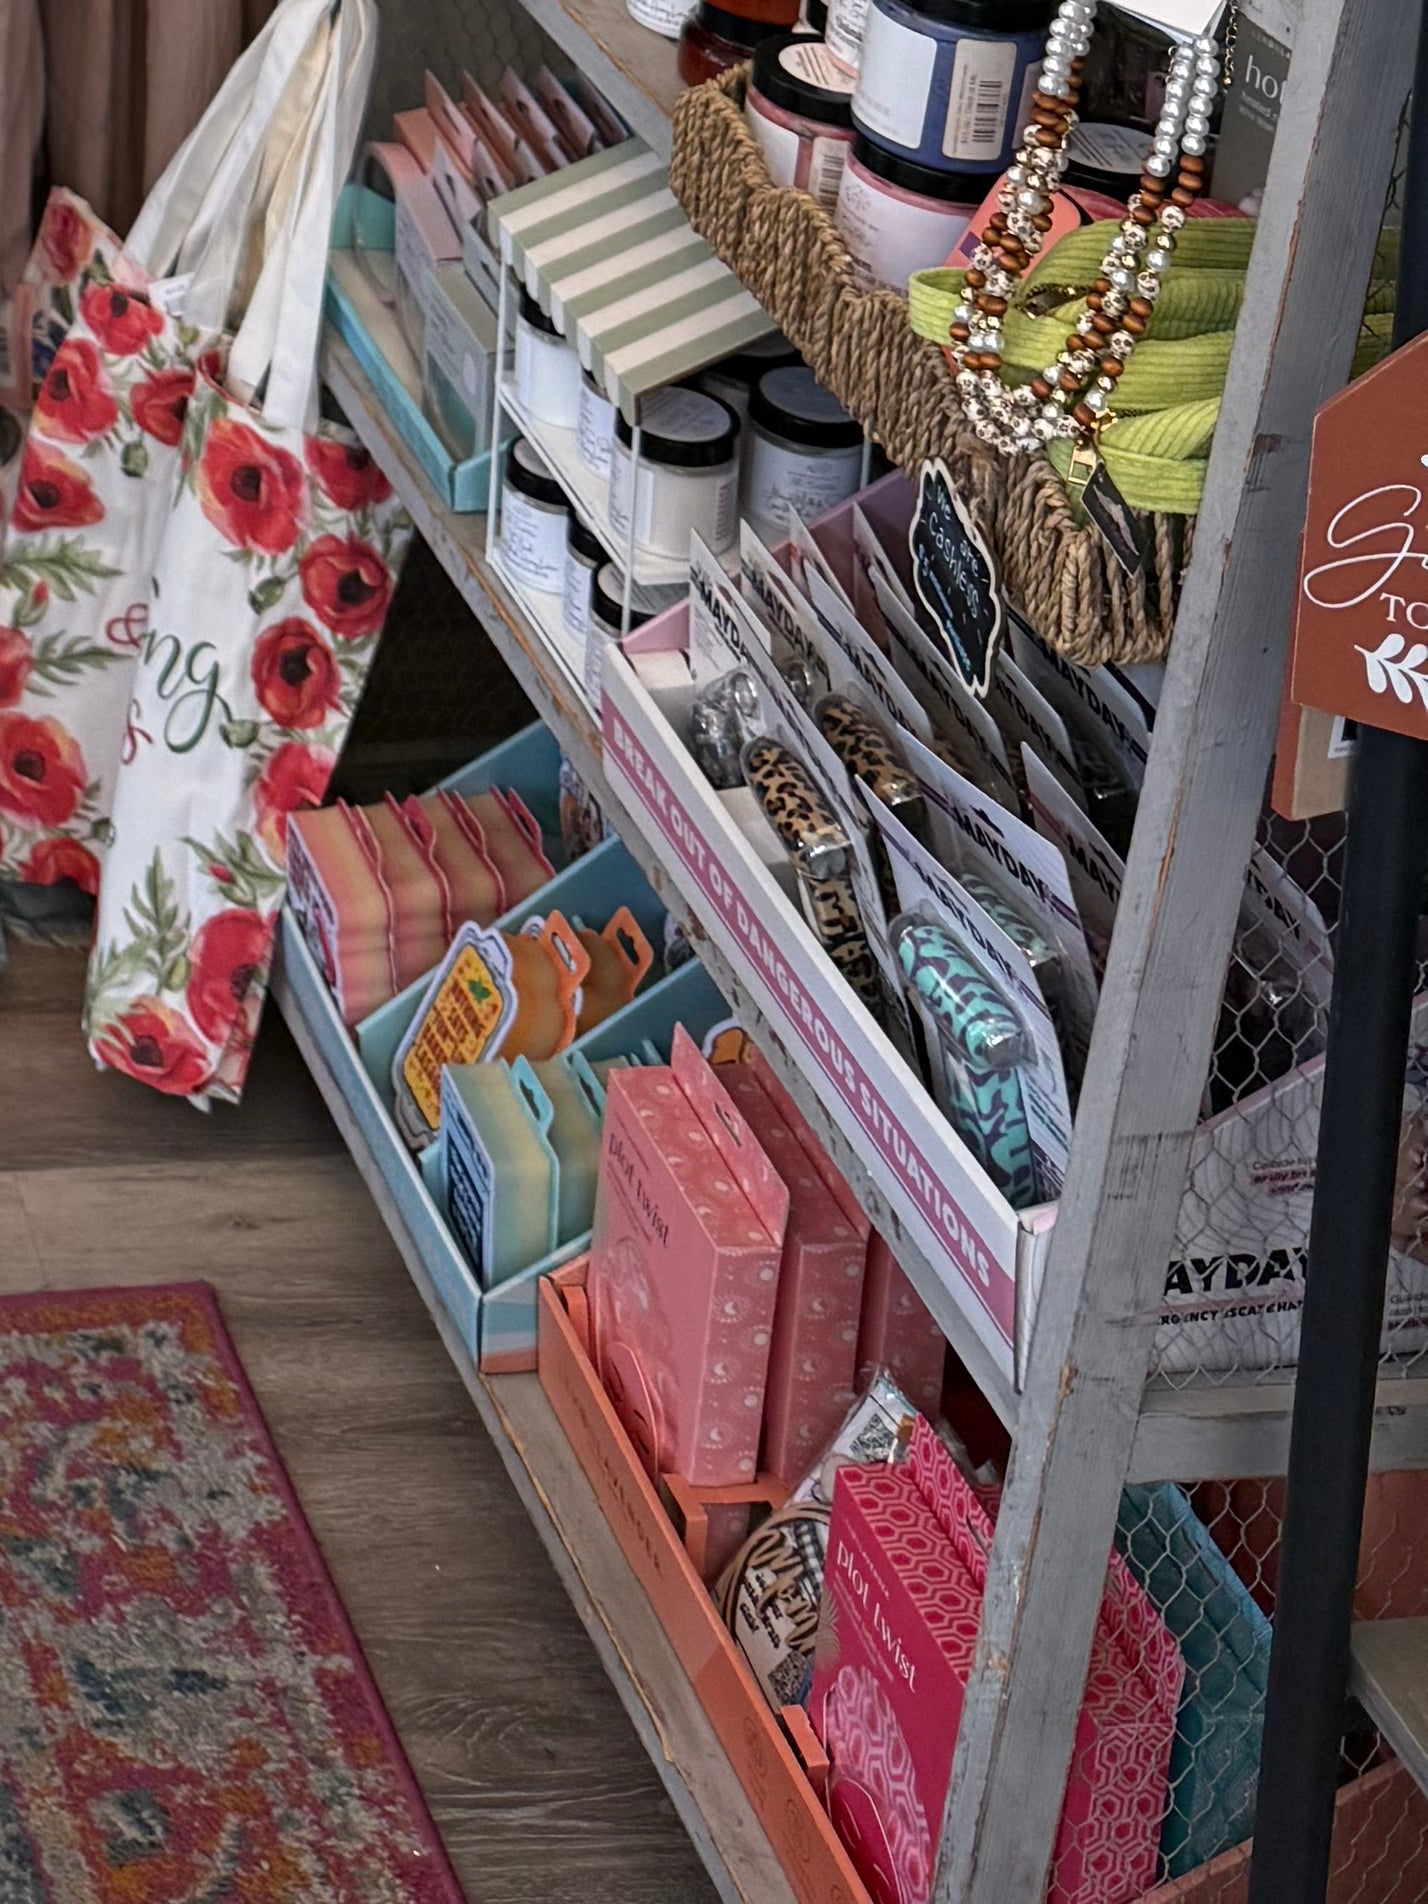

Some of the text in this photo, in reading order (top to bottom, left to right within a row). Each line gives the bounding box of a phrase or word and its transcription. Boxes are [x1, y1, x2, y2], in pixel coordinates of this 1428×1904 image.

[612, 717, 993, 1288] BREAK OUT OF DANGEROUS SITUATIONS
[836, 1540, 869, 1610] plot
[873, 1602, 917, 1694] twist
